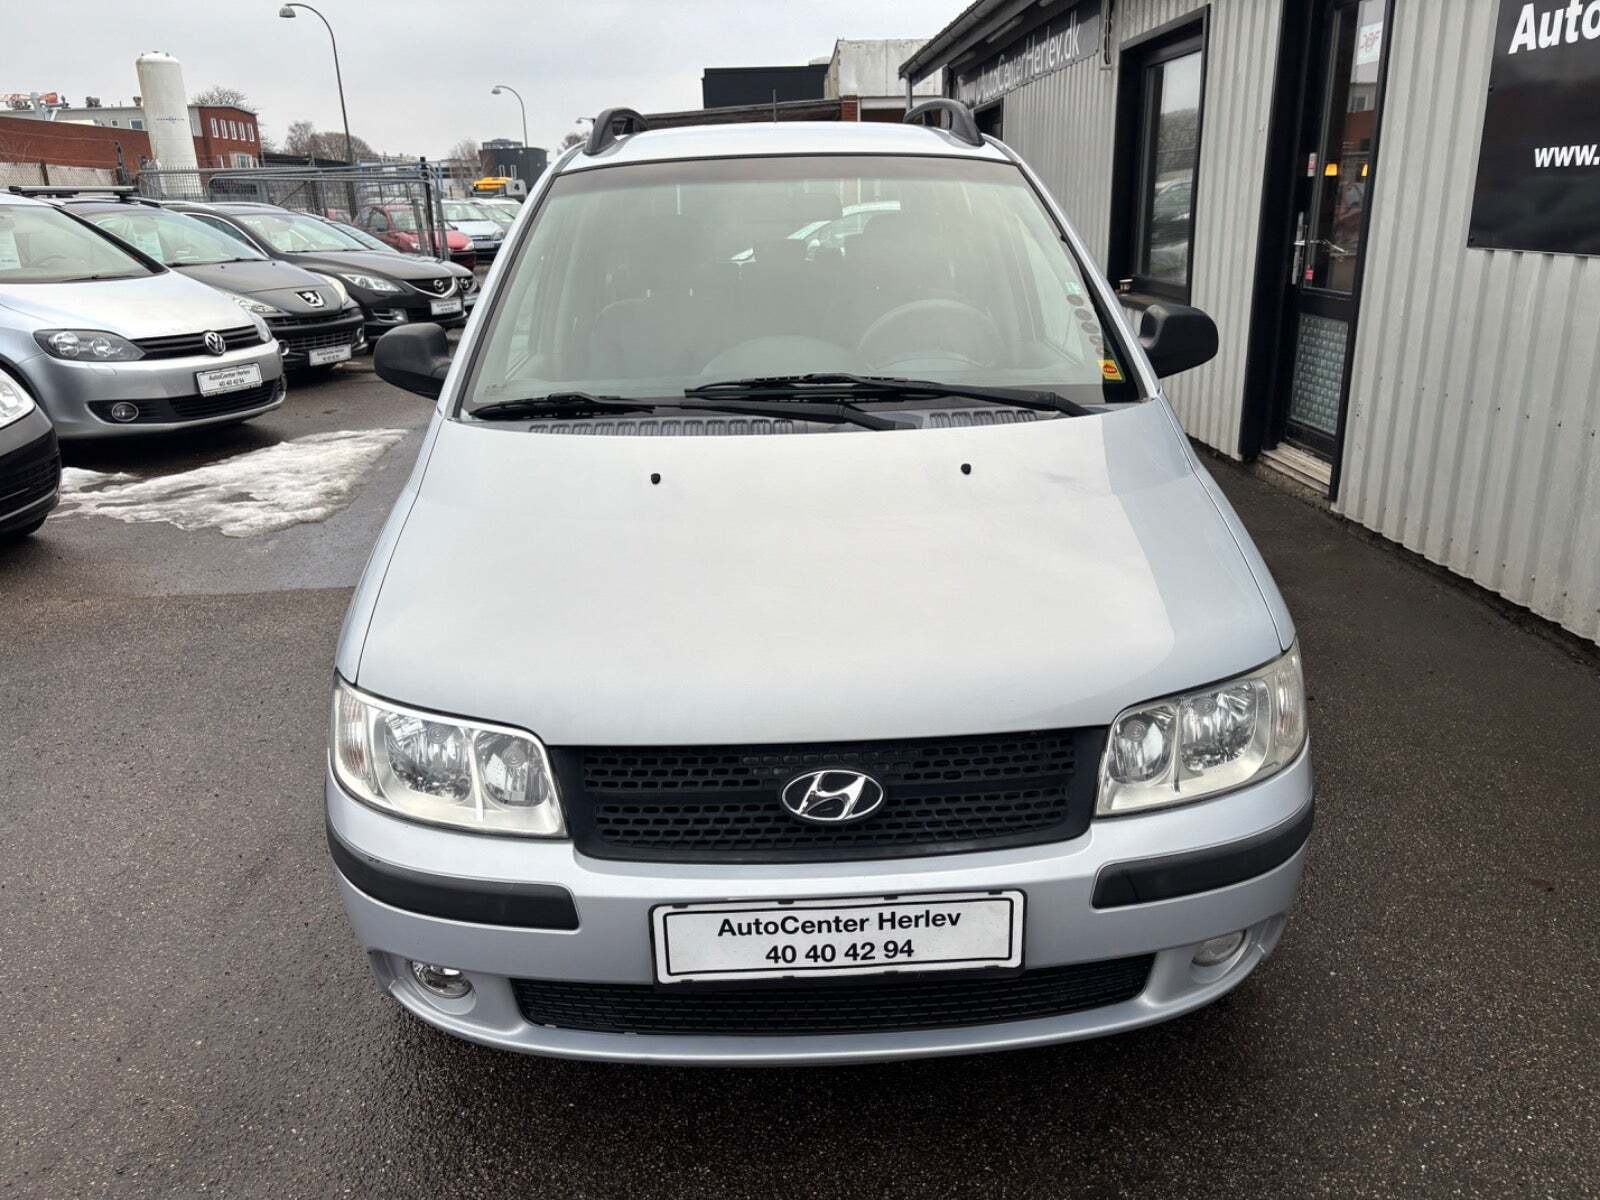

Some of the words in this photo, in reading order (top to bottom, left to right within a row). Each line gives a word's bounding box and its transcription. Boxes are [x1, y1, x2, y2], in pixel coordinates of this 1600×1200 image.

[1508, 0, 1600, 55] Auto
[1534, 144, 1600, 168] www.
[717, 914, 869, 937] AutoCenter
[878, 909, 962, 931] Herlev
[765, 944, 797, 964] 40
[804, 943, 837, 963] 40
[844, 942, 876, 961] 42
[883, 939, 914, 959] 94
